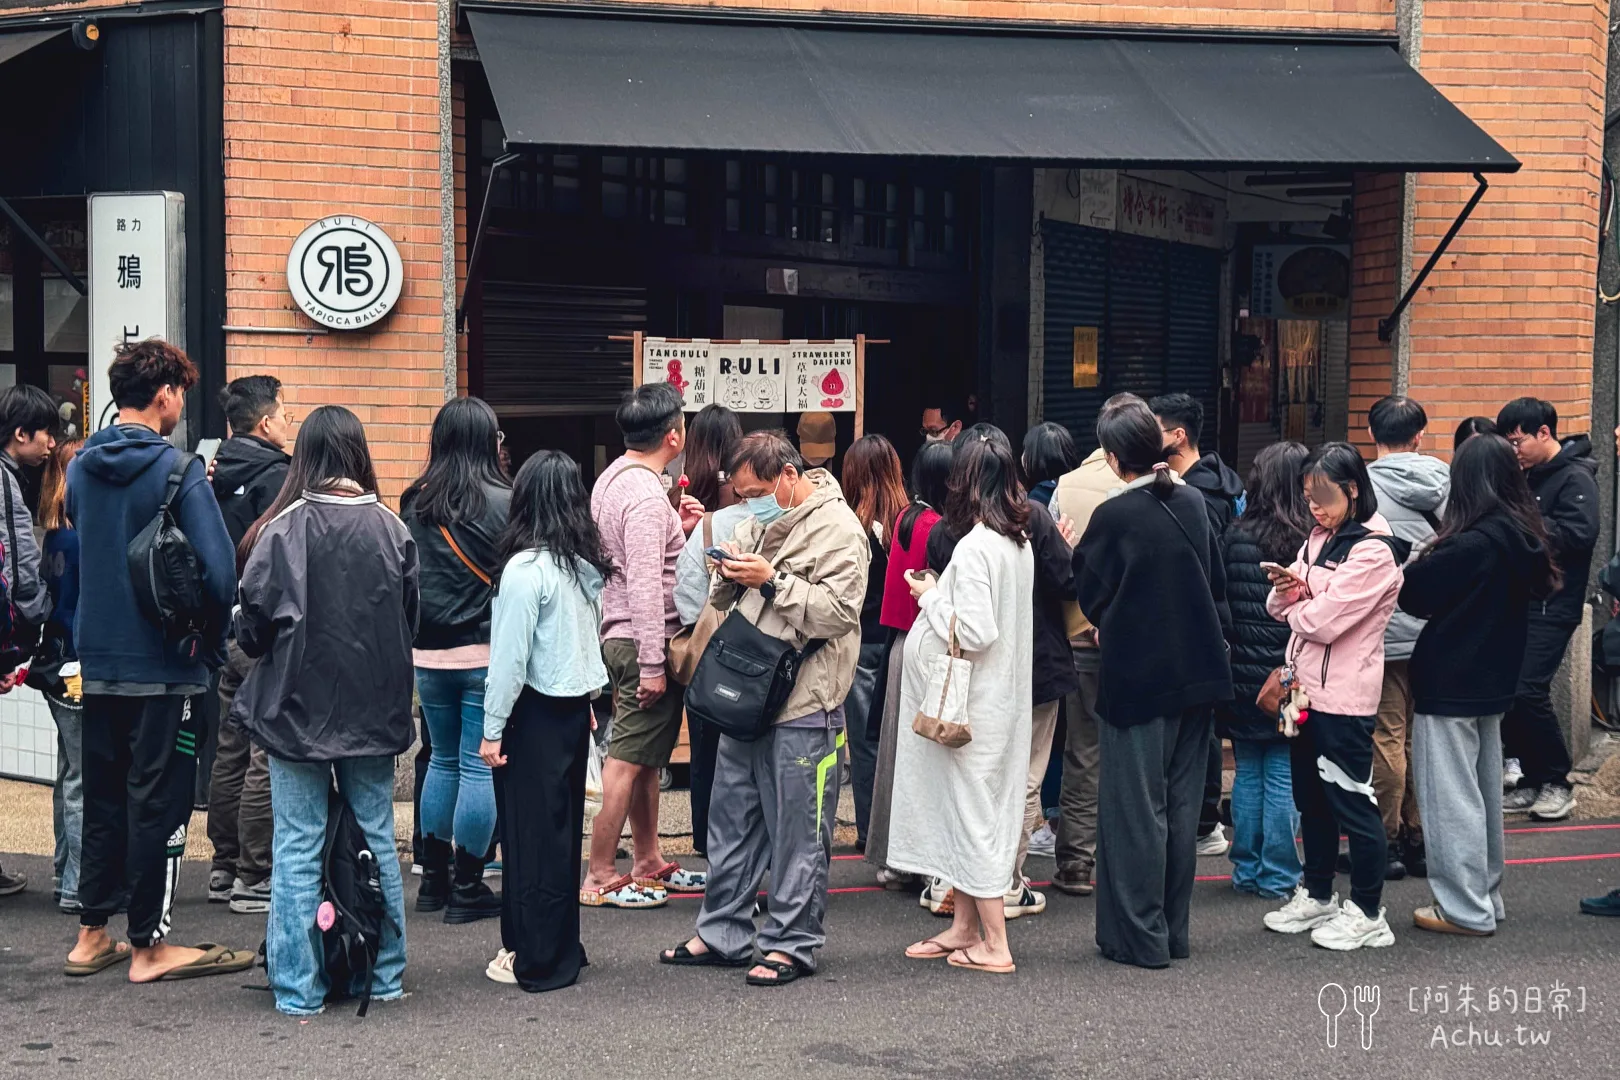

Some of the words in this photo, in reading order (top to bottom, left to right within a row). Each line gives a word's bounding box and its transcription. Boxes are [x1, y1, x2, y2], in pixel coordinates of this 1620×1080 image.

[117, 218, 141, 232] 路力
[320, 218, 370, 230] RULI
[304, 301, 350, 325] TAPIOCA
[355, 302, 387, 323] BALLS
[650, 349, 708, 358] TANGHULU
[719, 358, 780, 375] RULI
[694, 365, 706, 404] 糖葫蘆
[797, 362, 808, 409] 草莓大福
[167, 837, 186, 847] adid
